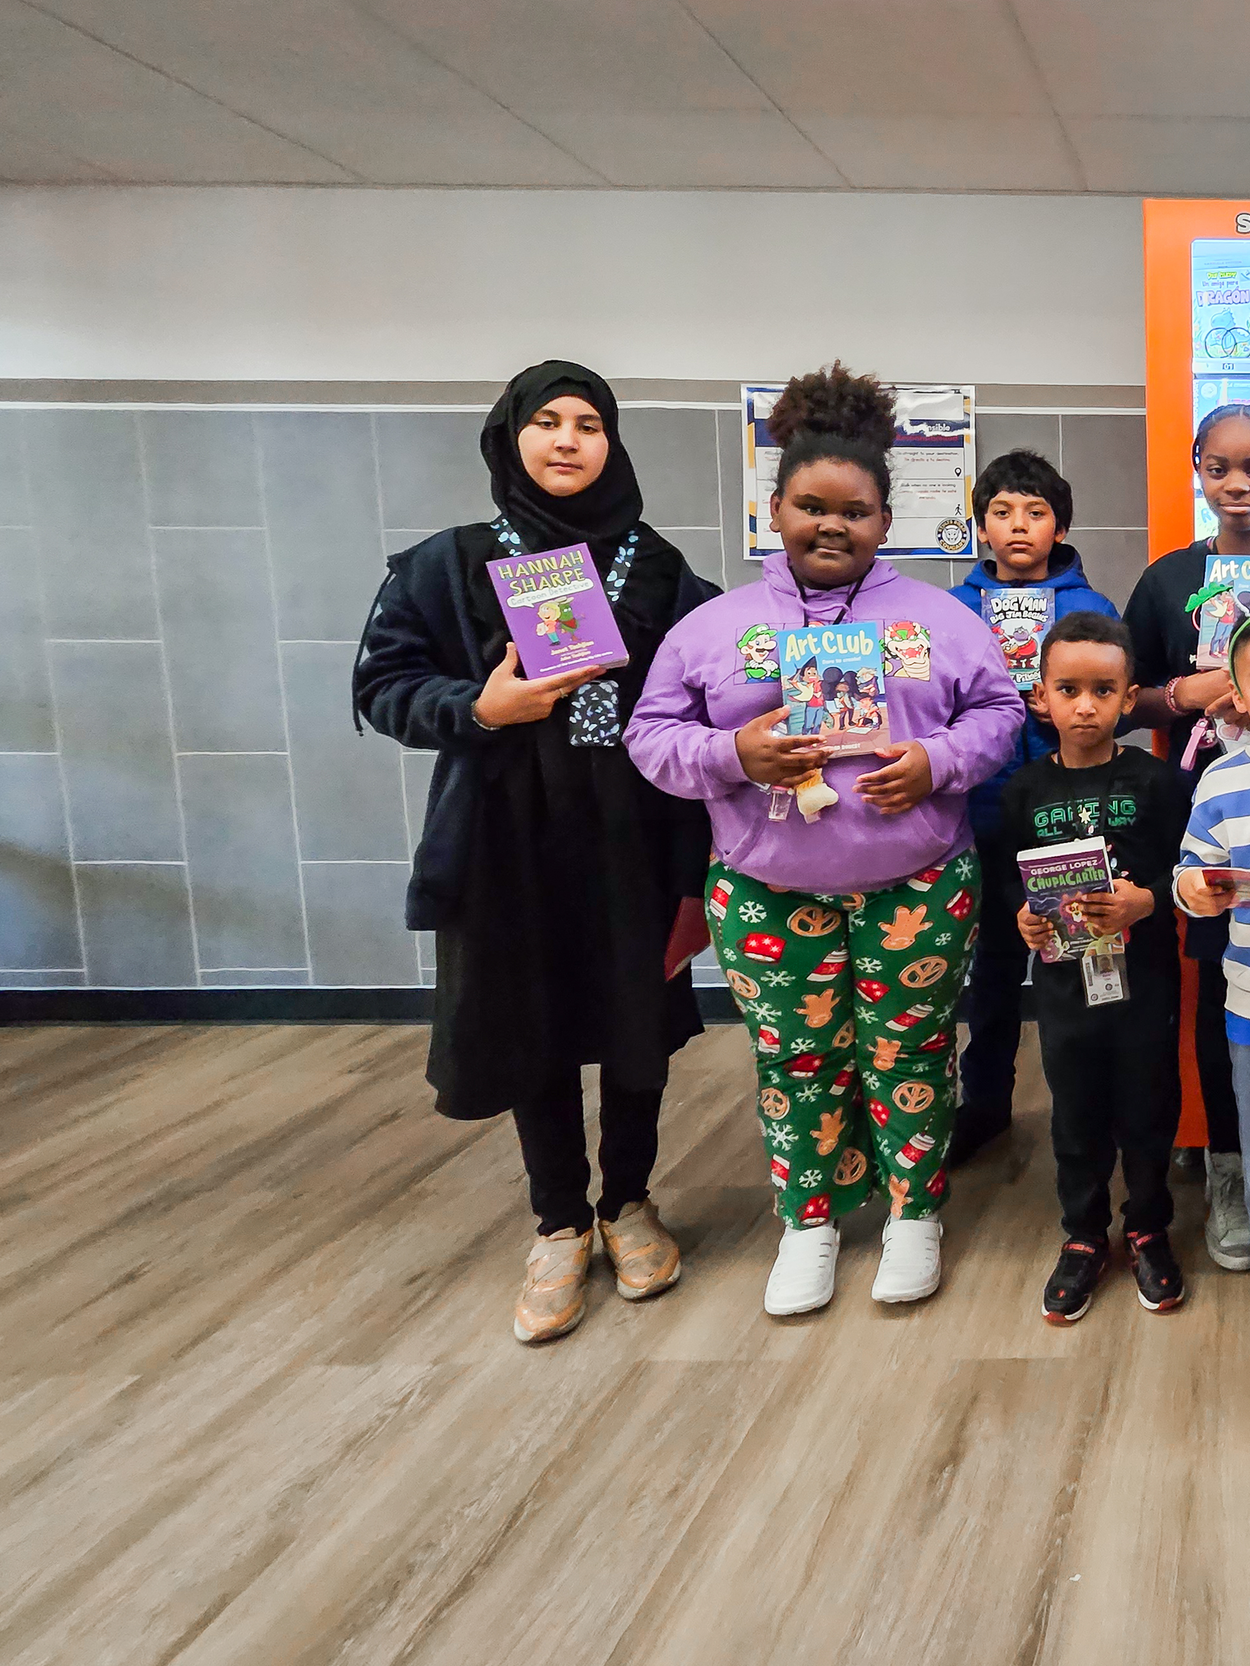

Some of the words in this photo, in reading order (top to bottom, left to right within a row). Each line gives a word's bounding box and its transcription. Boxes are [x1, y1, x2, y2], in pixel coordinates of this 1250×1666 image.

[1196, 286, 1250, 307] DRAGÓN
[497, 550, 584, 579] HANNAH
[1209, 558, 1240, 582] Art
[509, 568, 586, 596] SHARPE
[510, 593, 548, 606] Cartoon
[548, 581, 590, 596] Detective
[991, 597, 1020, 614] DOG
[1020, 596, 1048, 612] MAN
[990, 612, 1005, 624] BIG
[1006, 611, 1022, 619] JIM
[1022, 611, 1049, 622] BEGINS
[785, 632, 822, 663] Art
[822, 630, 874, 656] Club
[1036, 826, 1064, 838] ALL
[1108, 816, 1137, 826] WAY
[1030, 864, 1068, 876] GEORGE
[1070, 860, 1098, 870] LOPEZ
